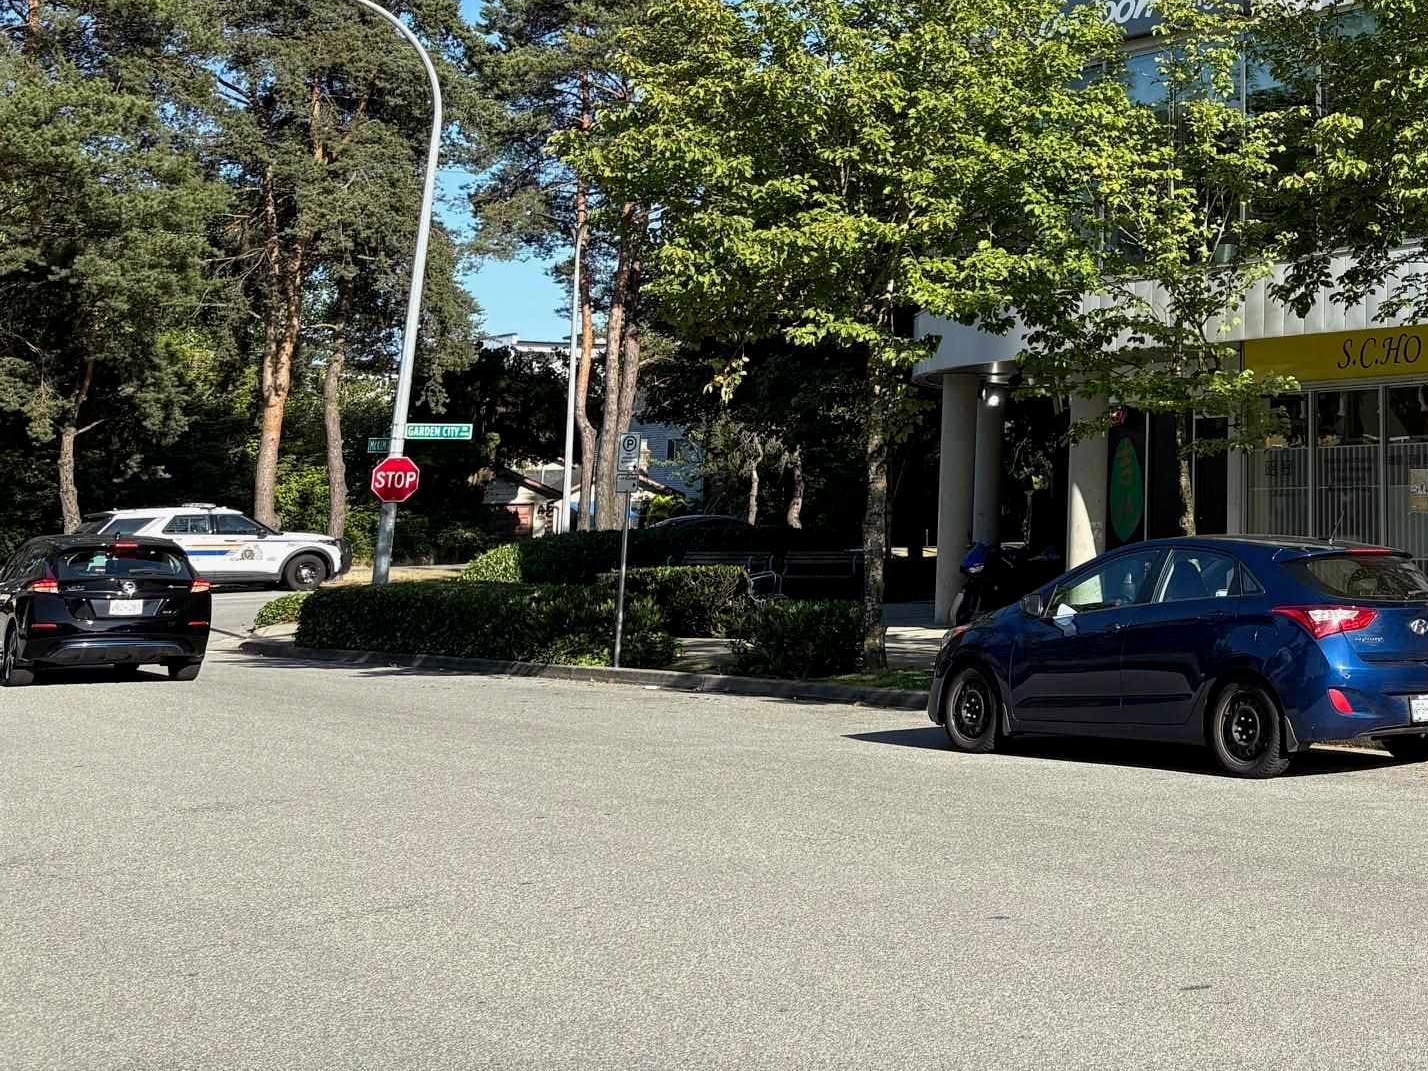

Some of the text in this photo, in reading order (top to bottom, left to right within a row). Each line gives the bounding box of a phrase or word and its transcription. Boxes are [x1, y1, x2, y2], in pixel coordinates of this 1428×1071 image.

[408, 425, 441, 437] GARDEN
[442, 425, 460, 437] CITY
[374, 471, 417, 489] STOP
